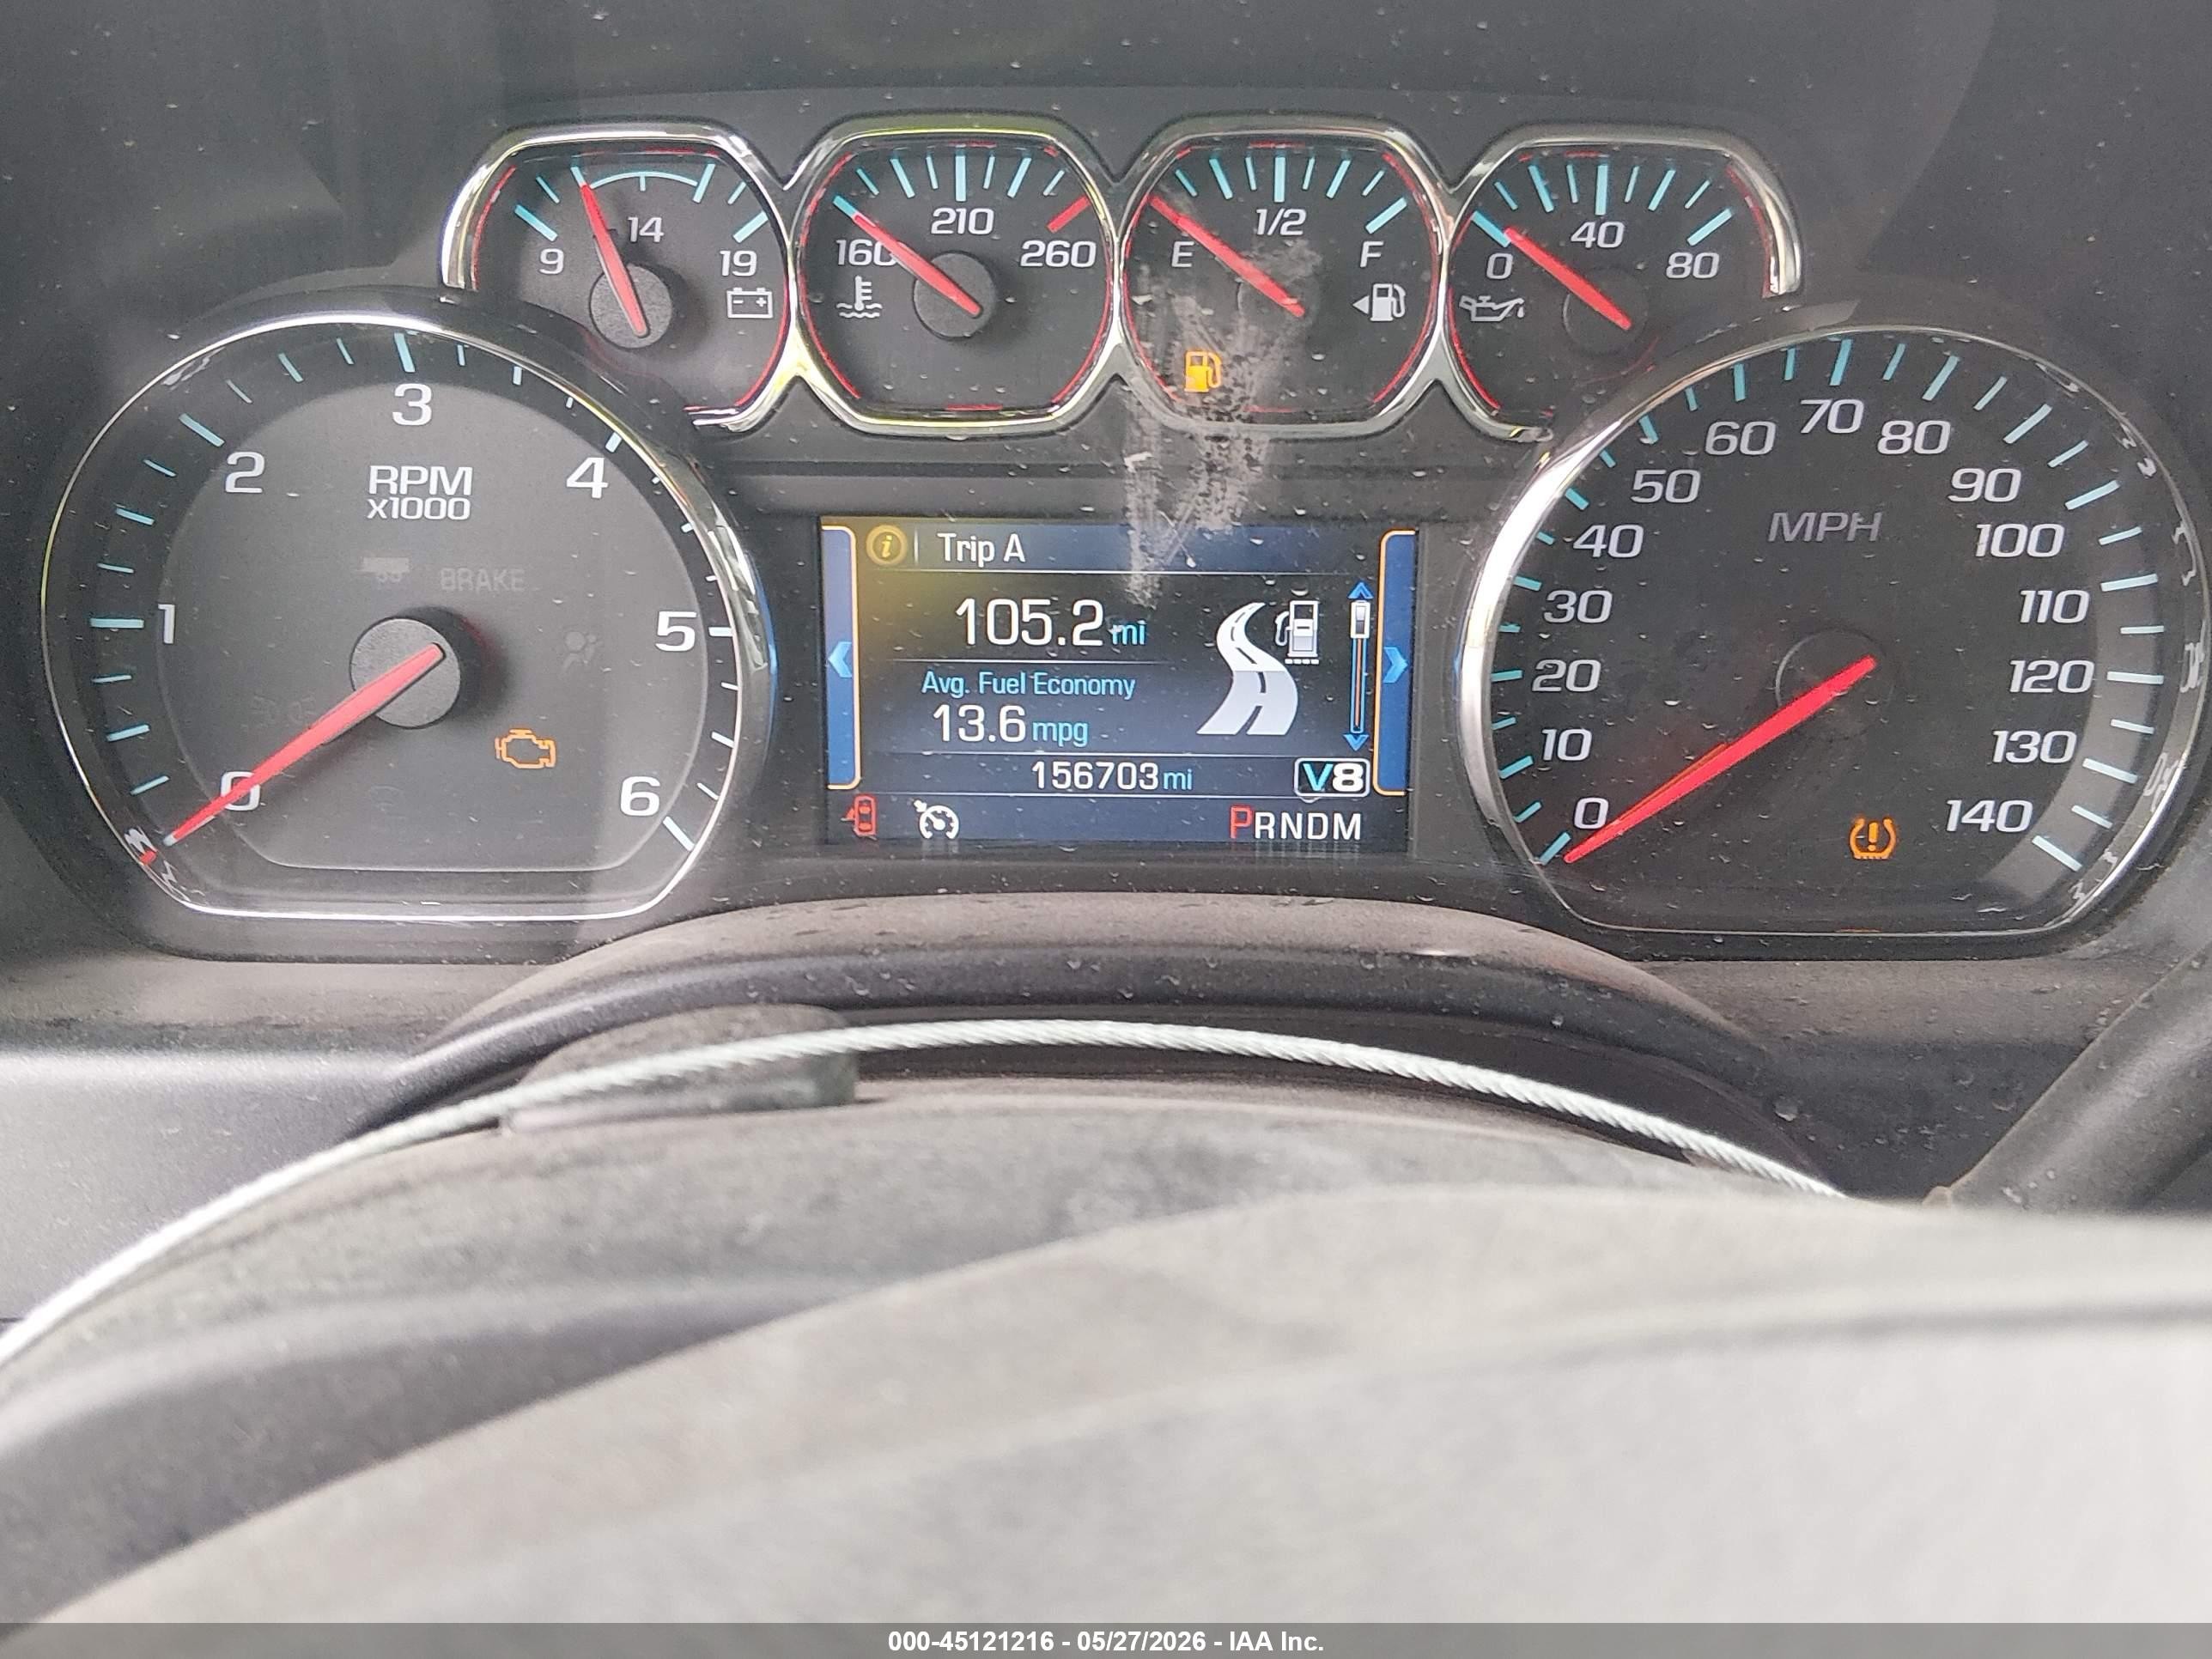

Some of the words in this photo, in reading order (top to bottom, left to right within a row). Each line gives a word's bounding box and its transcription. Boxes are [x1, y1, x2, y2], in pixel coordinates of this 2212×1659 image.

[627, 216, 665, 240] 14
[929, 207, 995, 236] 210
[1254, 208, 1307, 237] 1/2
[1570, 221, 1626, 250] 40
[538, 248, 565, 275] 9
[719, 250, 757, 277] 19
[836, 238, 898, 267] 160
[1019, 240, 1097, 269] 260
[1170, 241, 1194, 269] E
[1358, 240, 1383, 268] F
[1484, 252, 1514, 281] 0
[1664, 252, 1721, 281] 80
[391, 381, 434, 427] 3
[1797, 398, 1865, 434] 70
[1704, 420, 1777, 457] 60
[1875, 419, 1952, 456] 80
[222, 450, 267, 495] 2
[367, 464, 474, 495] RPM
[564, 455, 610, 500] 4
[1630, 468, 1702, 505] 50
[1948, 466, 2022, 503] 90
[366, 496, 471, 521] x1000
[1765, 510, 1885, 543] MPH
[936, 532, 996, 565] Trip
[1004, 532, 1027, 563] A
[1571, 522, 1645, 559] 40
[1974, 522, 2064, 558] 100
[439, 567, 526, 592] BRAKE
[954, 597, 1104, 647] 105.2
[1111, 620, 1147, 647] mi
[1541, 588, 1613, 624] 30
[2018, 587, 2091, 624] 110
[156, 603, 177, 646] 1
[654, 610, 698, 653] 5
[921, 669, 969, 697] Avg.
[978, 669, 1026, 696] Fuel
[1033, 670, 1136, 699] Economy
[1530, 657, 1602, 693] 20
[2008, 657, 2095, 694] 120
[932, 703, 1026, 744] 13.6
[1032, 720, 1089, 748] mpg
[1540, 726, 1593, 763] 10
[1990, 727, 2078, 764] 130
[219, 769, 261, 812] 0
[1030, 760, 1159, 791] 156703
[1162, 766, 1194, 791] mi
[1303, 761, 1364, 793] V8
[617, 775, 661, 817] 6
[1572, 795, 1610, 831] 0
[1944, 797, 2033, 833] 140
